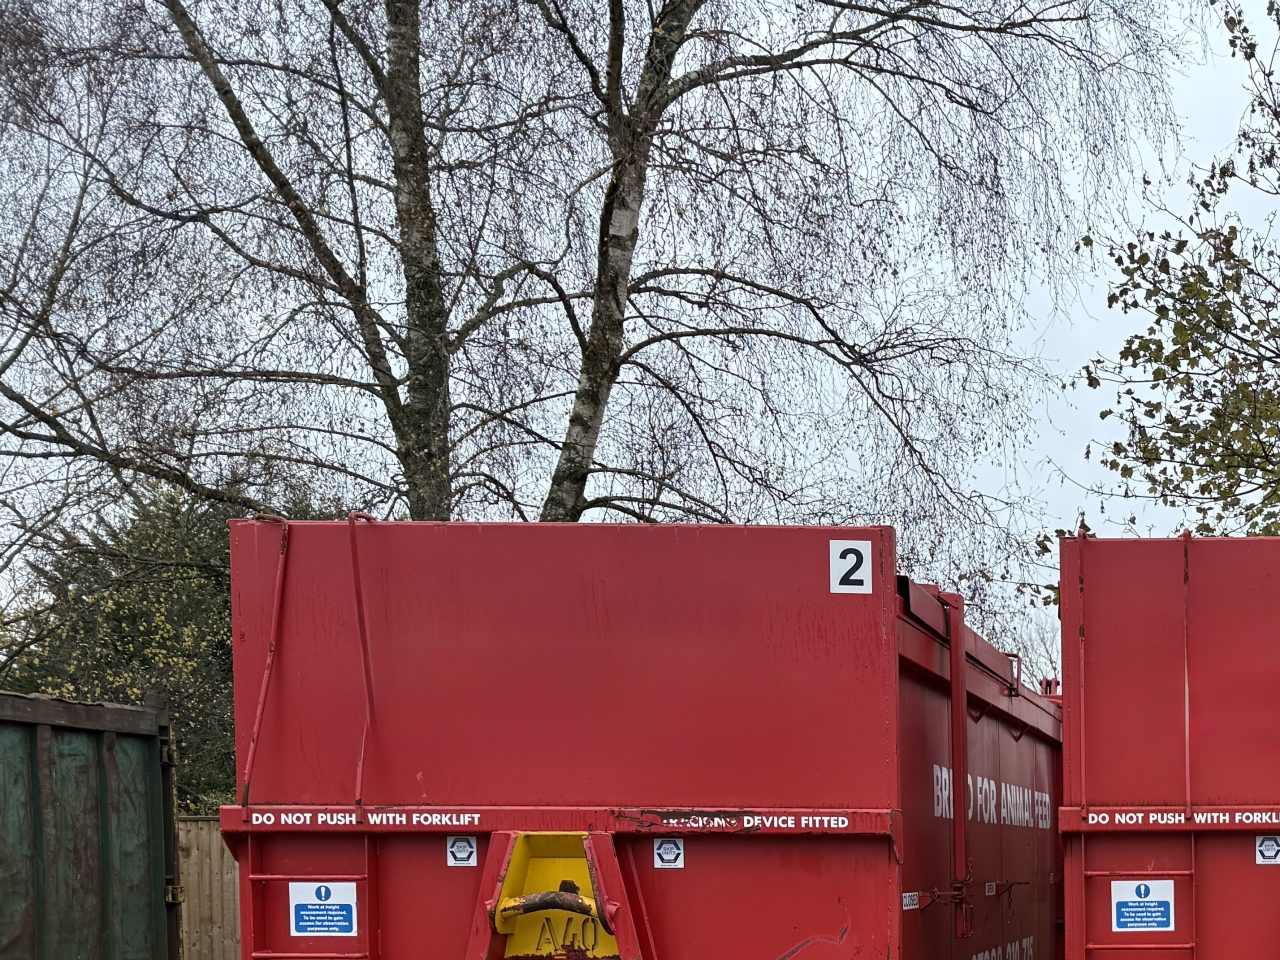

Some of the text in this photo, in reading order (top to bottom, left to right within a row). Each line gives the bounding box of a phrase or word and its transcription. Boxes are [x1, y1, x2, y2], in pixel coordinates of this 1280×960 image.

[838, 547, 864, 586] 2
[933, 764, 1051, 829] BRD FOR ANIMAL FEED
[252, 812, 481, 826] DO NOT PUSH WITH FORKLIFT
[743, 816, 796, 828] DEVICE
[801, 816, 849, 828] FITTED
[1088, 813, 1110, 825] DO
[1114, 813, 1144, 825] NOT
[1149, 813, 1185, 824] PUSH
[1193, 812, 1230, 824] WITH
[536, 916, 597, 952] A40
